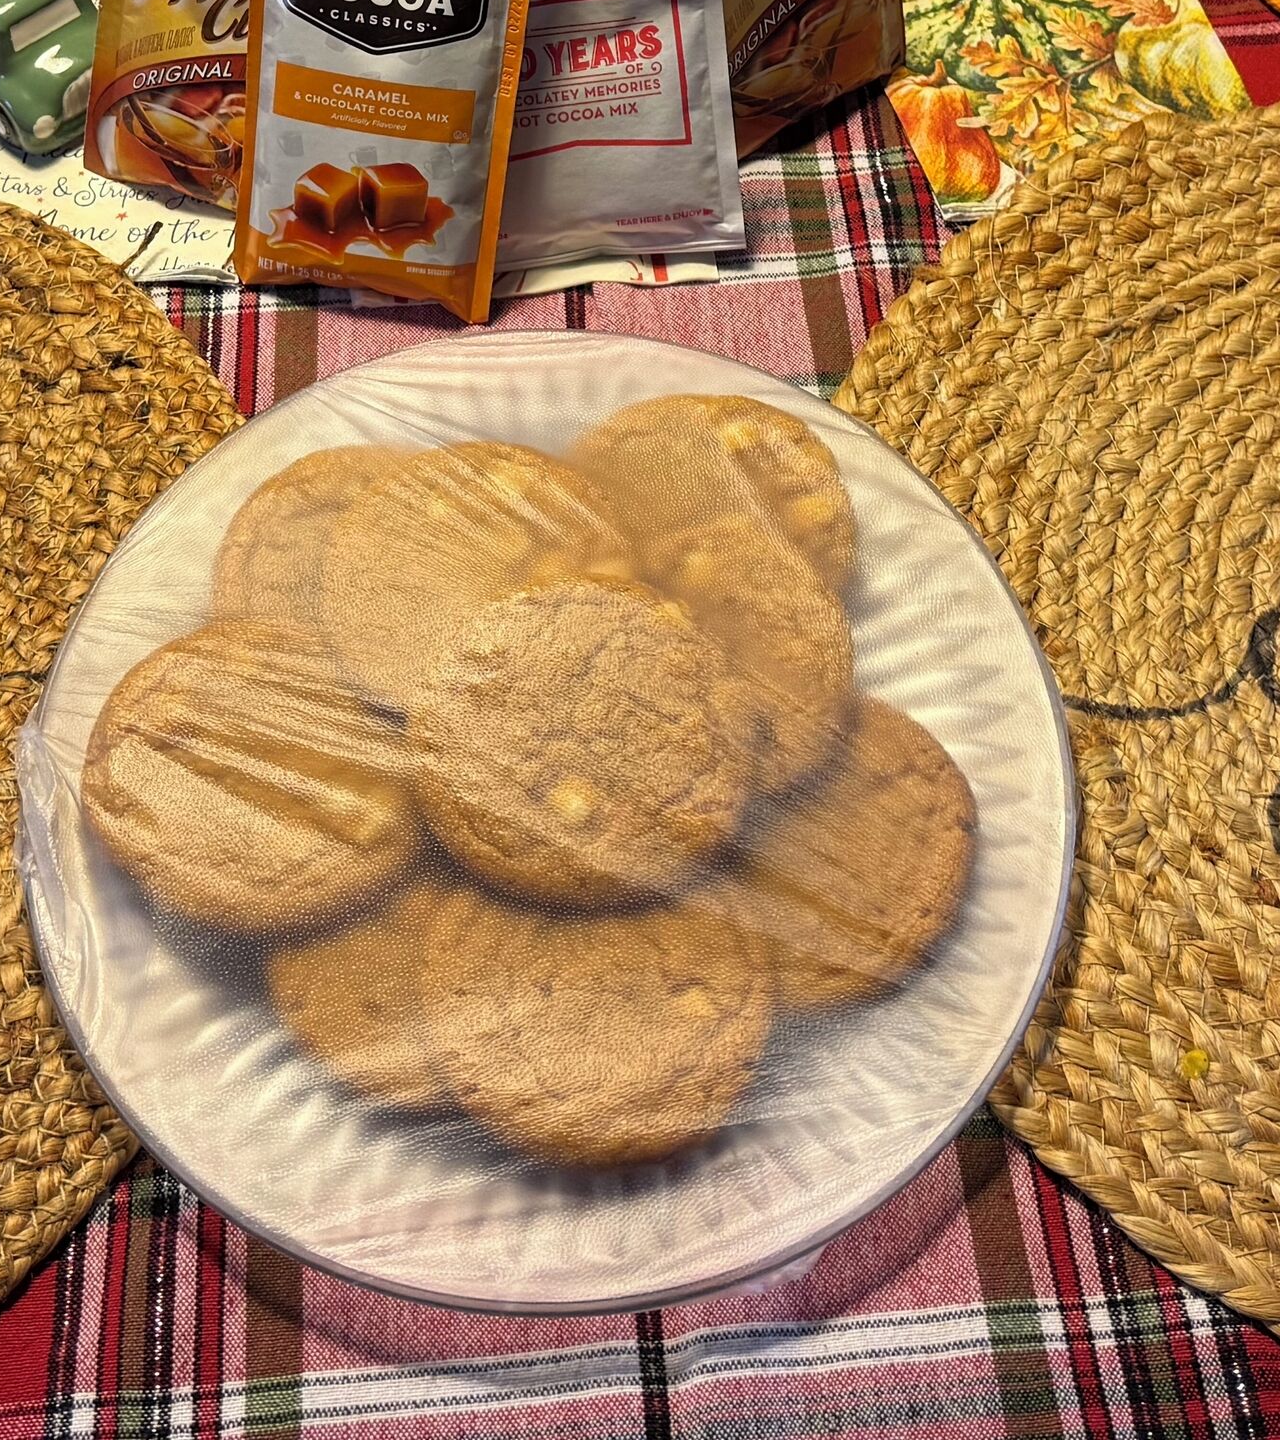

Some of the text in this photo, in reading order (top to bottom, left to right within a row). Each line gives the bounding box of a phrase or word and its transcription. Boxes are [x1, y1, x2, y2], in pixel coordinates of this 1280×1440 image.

[330, 9, 426, 33] CLASSICS
[544, 23, 664, 76] YEARS
[132, 60, 233, 90] ORIGINAL
[625, 61, 644, 75] OF
[332, 82, 411, 106] CARAMEL
[584, 78, 662, 99] MEMORIES
[294, 90, 450, 124] & CHOCOLATE COCOA MIX
[546, 108, 605, 125] COCOA
[610, 101, 639, 117] MIX
[330, 112, 407, 132] Artificially Flavored
[53, 176, 72, 198] &
[74, 176, 160, 208] Stripes
[616, 217, 638, 227] TEAR
[640, 215, 663, 225] HERE
[673, 209, 702, 221] ENJOY
[168, 217, 219, 245] the
[257, 255, 273, 271] NET
[276, 261, 288, 274] WT
[291, 265, 310, 279] 1.25
